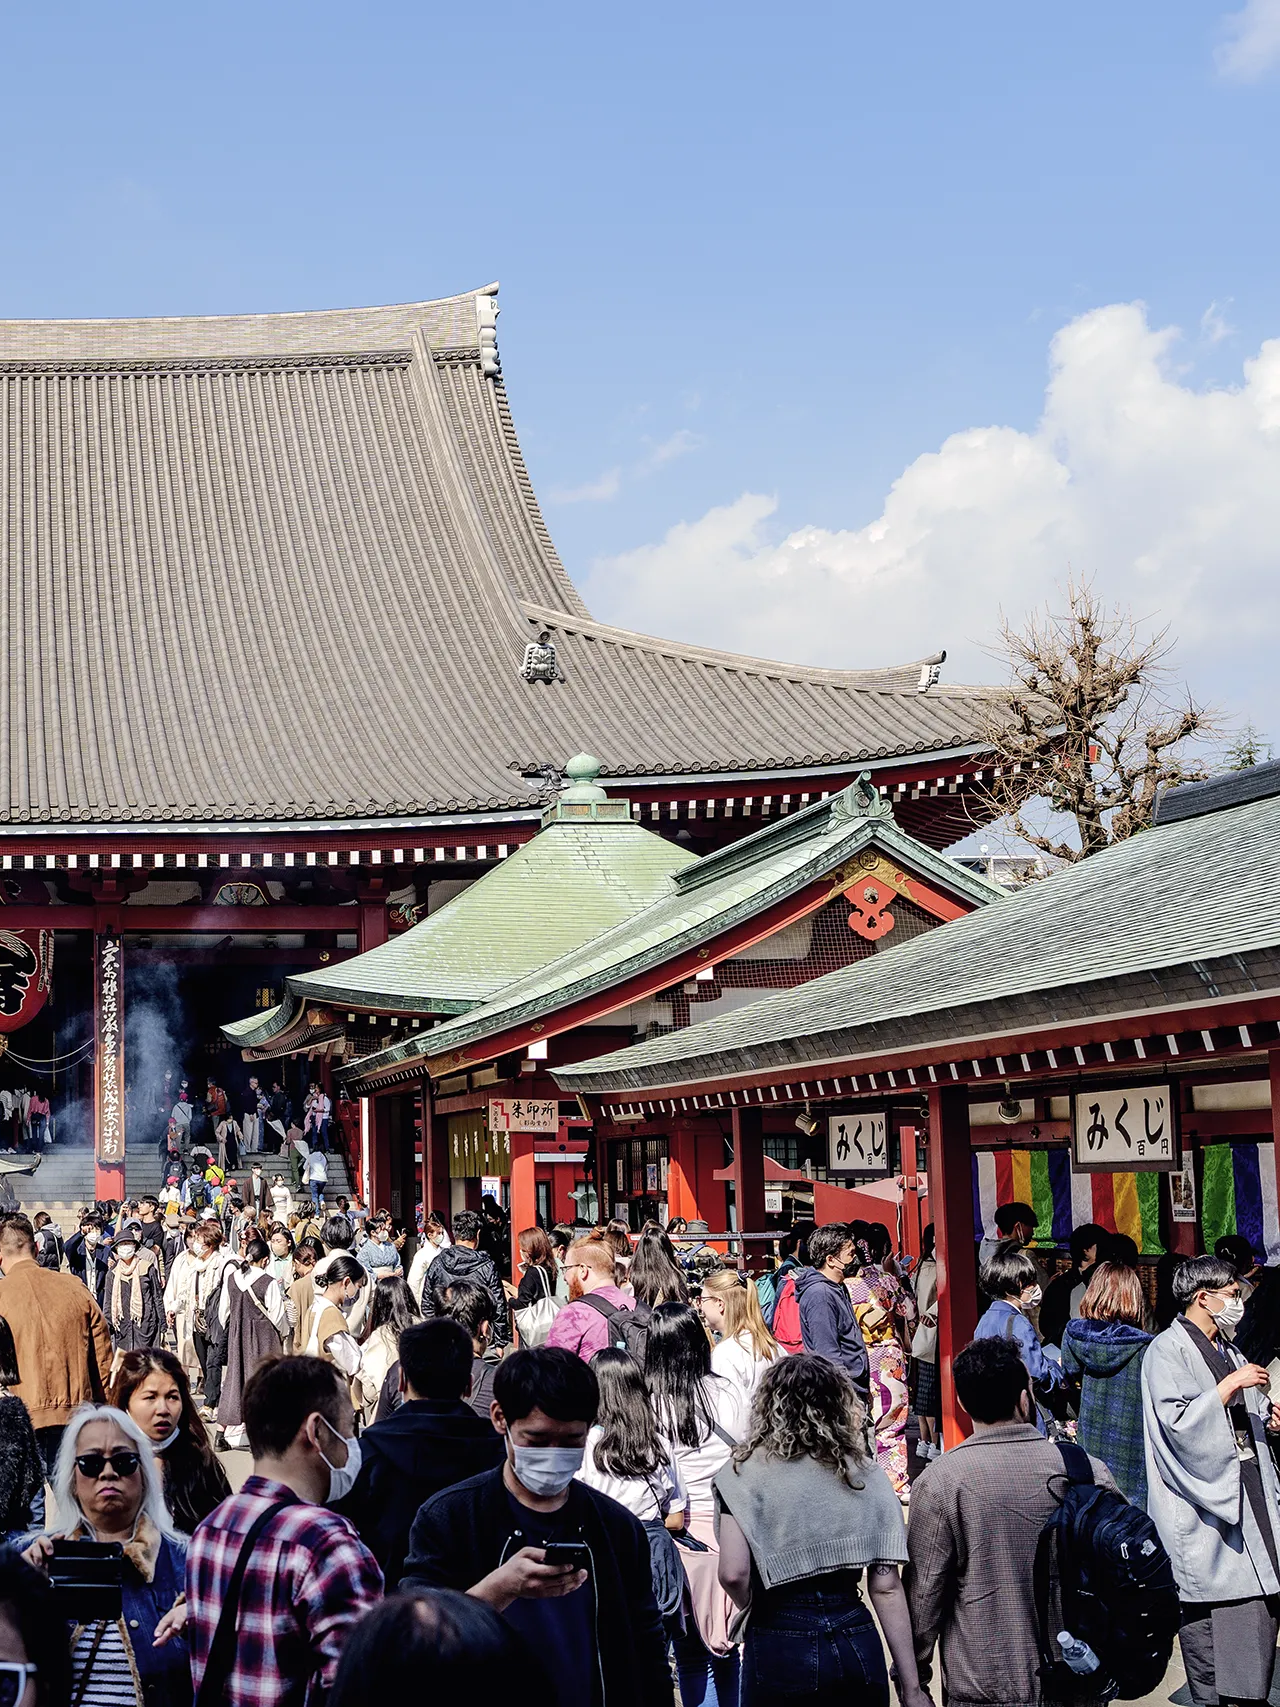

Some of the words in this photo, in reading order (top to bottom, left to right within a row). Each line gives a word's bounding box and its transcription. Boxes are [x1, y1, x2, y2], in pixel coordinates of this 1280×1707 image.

[511, 1100, 556, 1120] 朱印所
[1087, 1097, 1165, 1150] みくじ
[836, 1120, 884, 1161] みくじ
